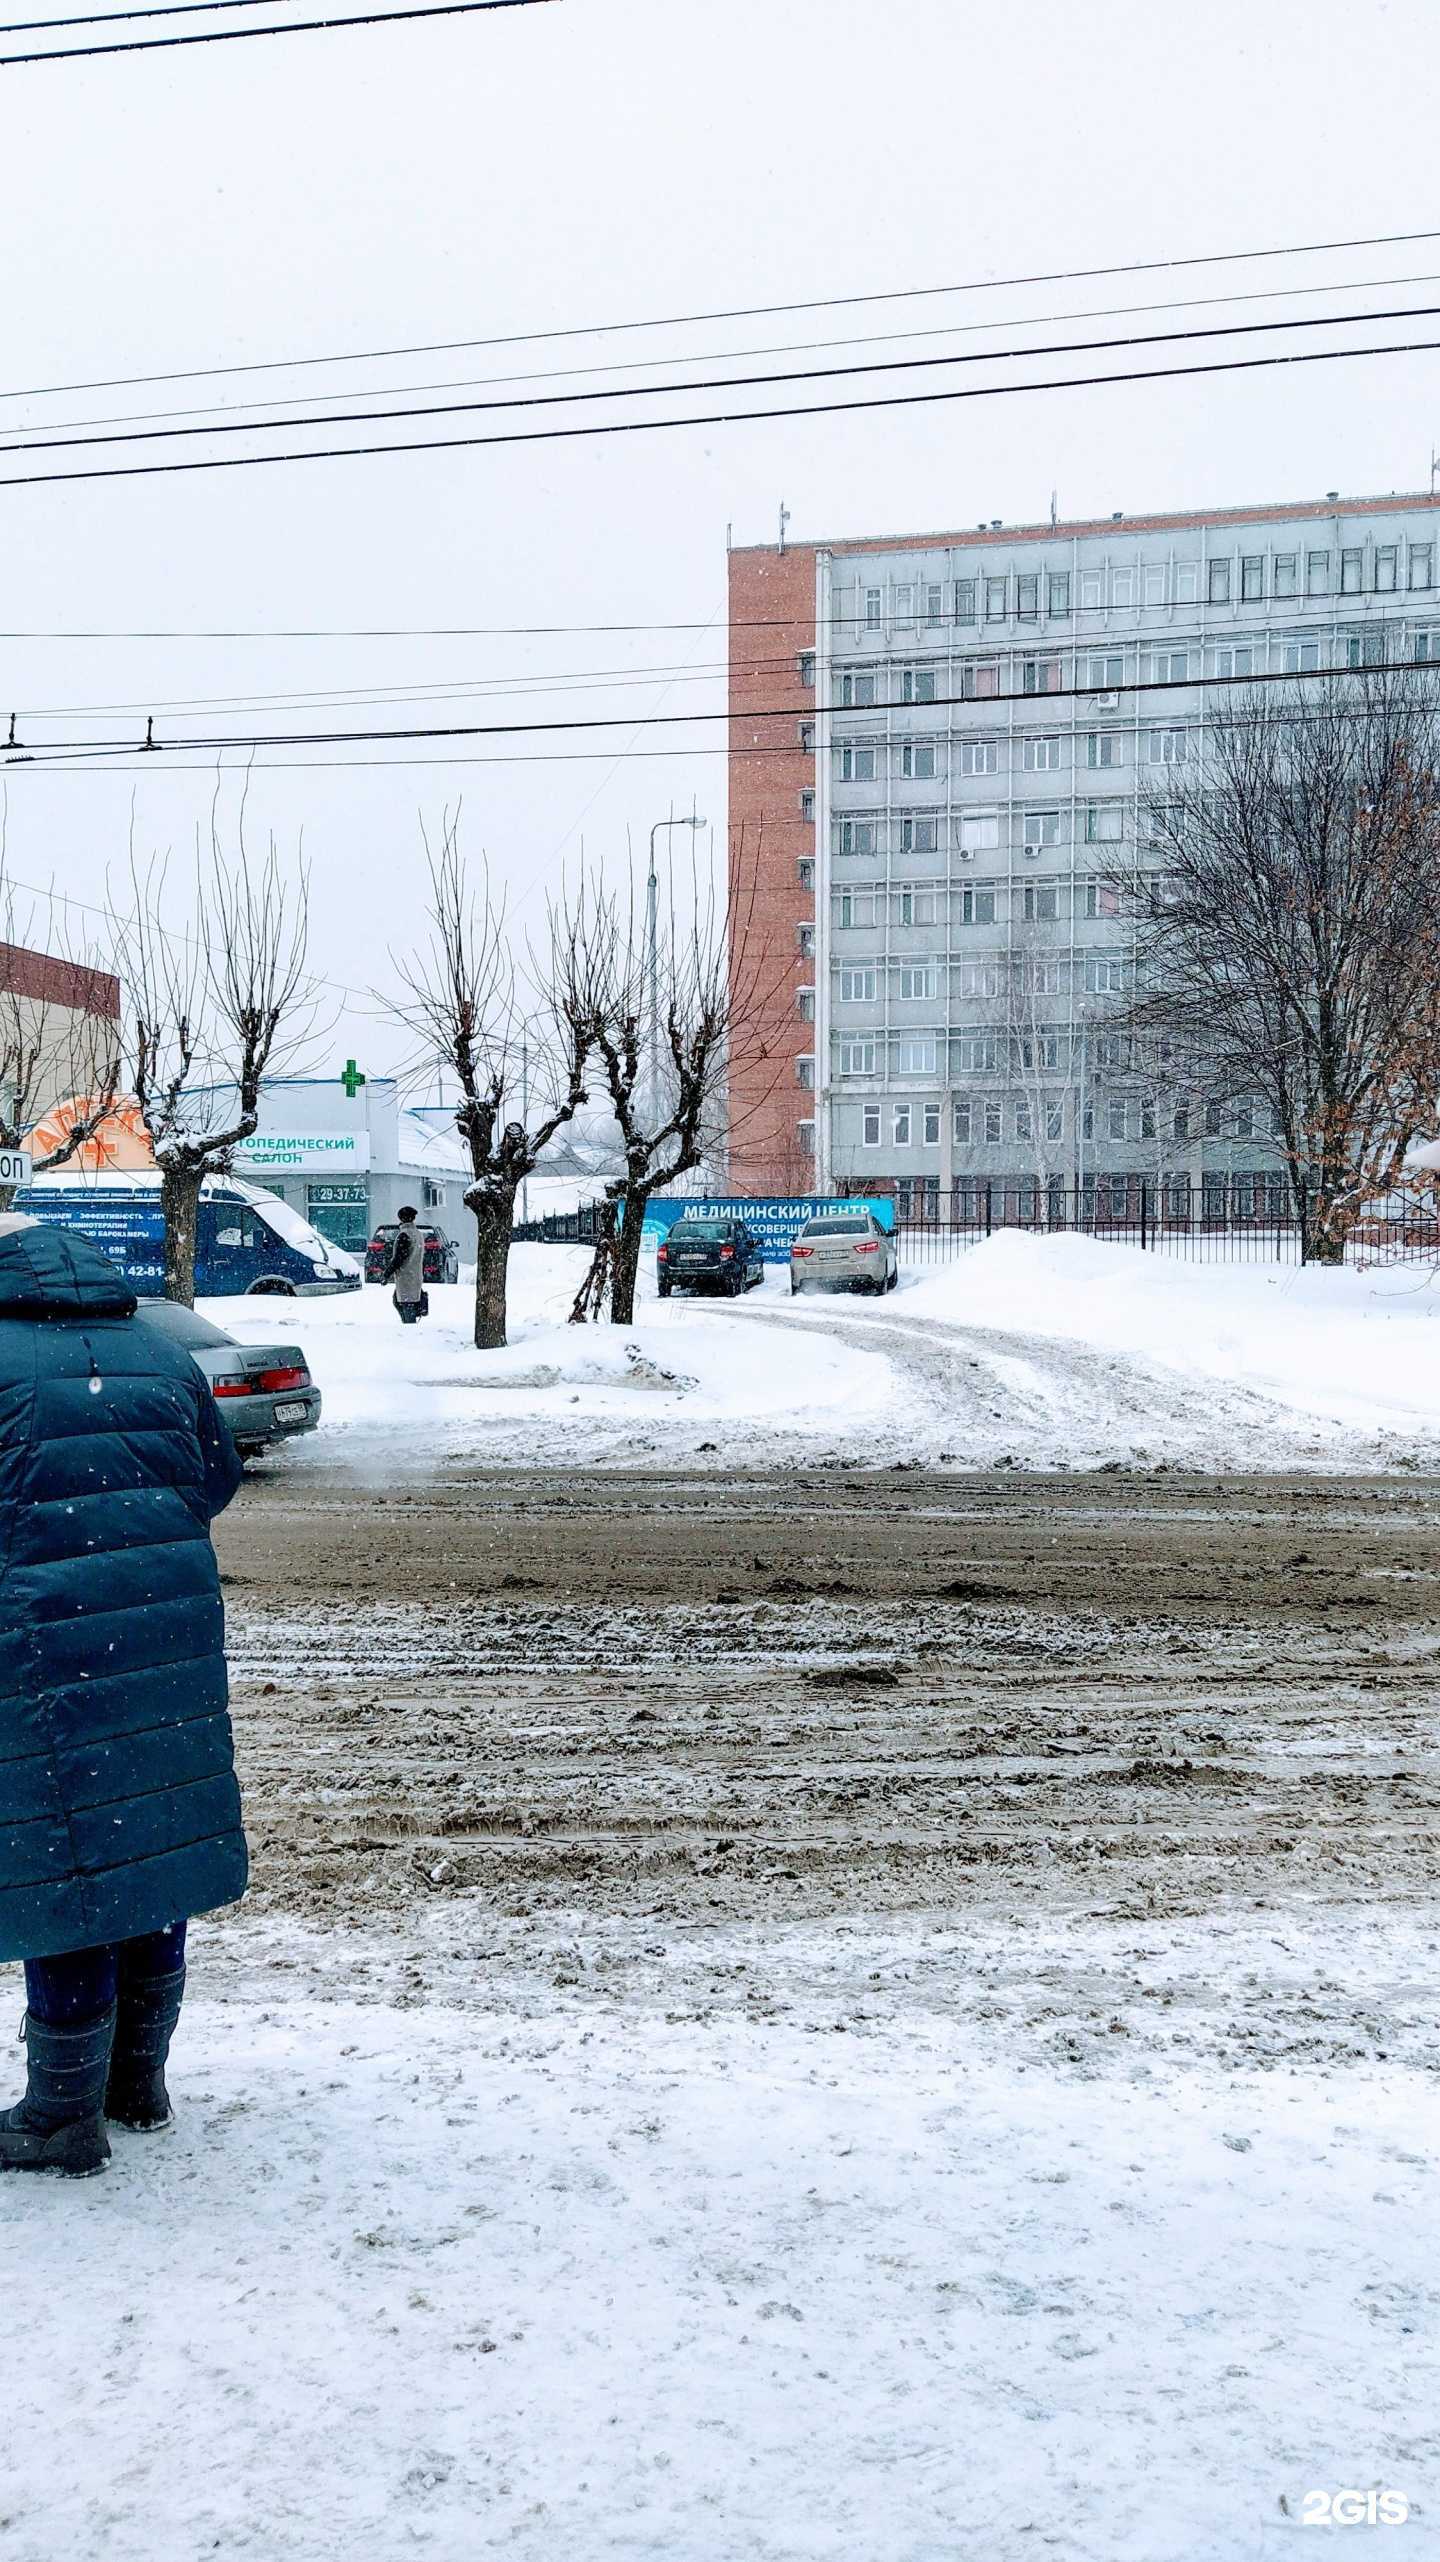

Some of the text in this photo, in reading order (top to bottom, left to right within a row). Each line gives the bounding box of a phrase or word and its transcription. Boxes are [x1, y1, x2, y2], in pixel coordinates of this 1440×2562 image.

[252, 1153, 303, 1164] САЛОН
[320, 1187, 366, 1200] 29-37-73
[79, 1212, 144, 1220] ЭФФЕКТИВНОСТЬ
[683, 1203, 870, 1219] МЕДИЦИНСКИЙ ЦЕНТР
[763, 1236, 794, 1248] АЧЕЙ
[108, 1245, 127, 1254] 69Б
